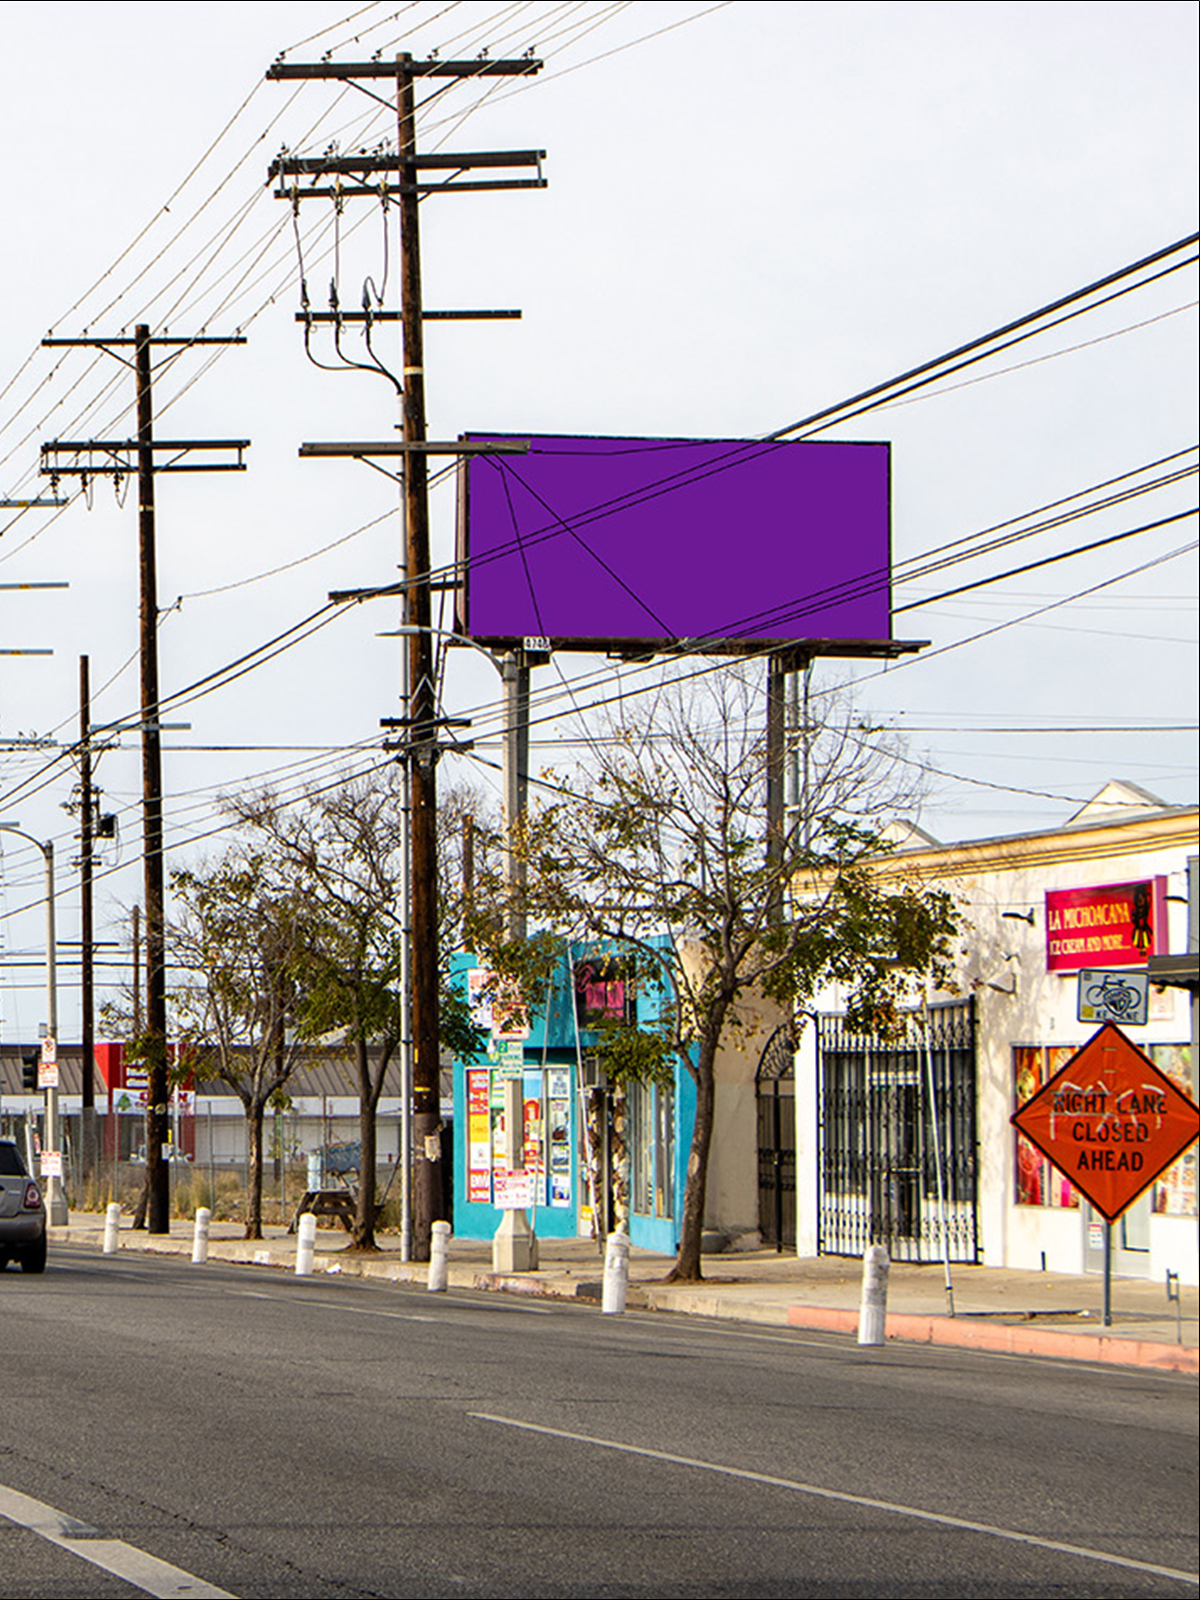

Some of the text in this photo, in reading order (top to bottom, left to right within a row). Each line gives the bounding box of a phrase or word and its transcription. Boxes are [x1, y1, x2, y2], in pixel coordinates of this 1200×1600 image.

[1048, 902, 1131, 931] LA MICHOACANA
[1061, 937, 1085, 955] CREAM
[1086, 935, 1101, 952] AND
[1053, 1093, 1168, 1114] RIGHT LANE
[1072, 1121, 1149, 1143] CLOSED
[1077, 1150, 1144, 1172] AHEAD
